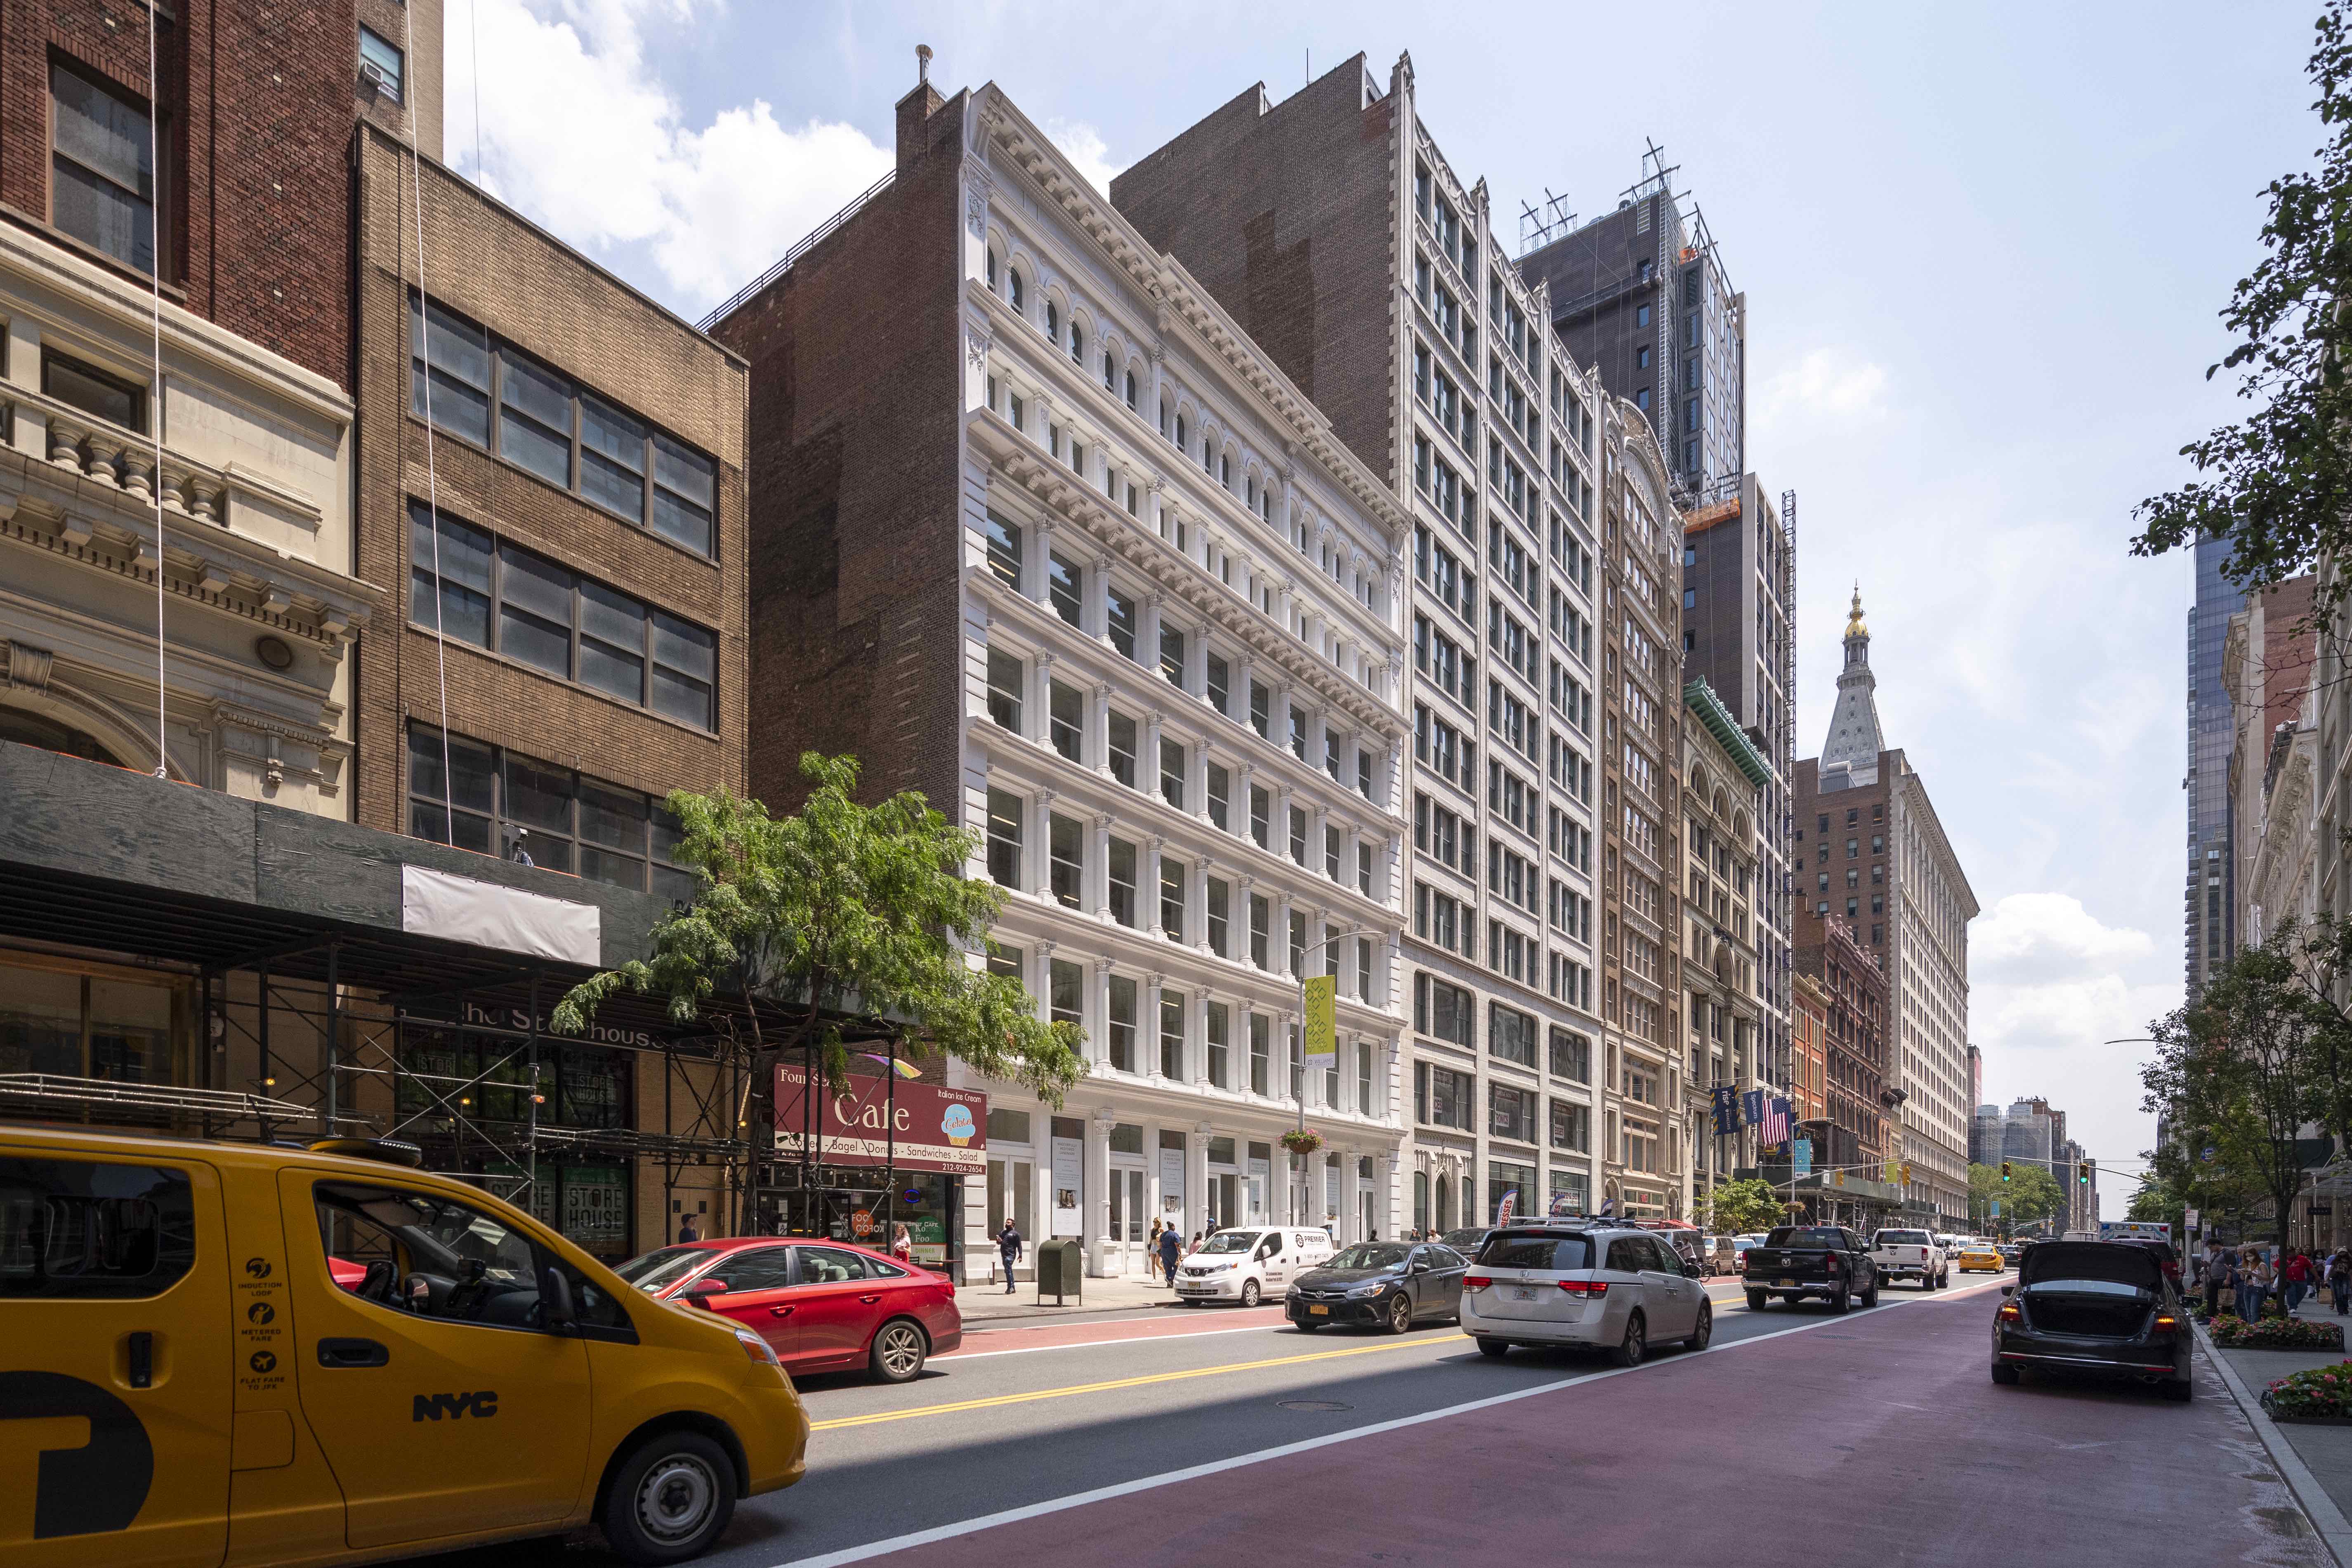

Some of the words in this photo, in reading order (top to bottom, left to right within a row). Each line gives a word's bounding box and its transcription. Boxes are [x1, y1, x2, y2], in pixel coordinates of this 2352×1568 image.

[938, 1089, 955, 1099] Italian
[965, 1093, 981, 1103] Cream
[1722, 1090, 1730, 1105] rise
[835, 1093, 910, 1131] Cafe
[832, 1139, 858, 1153] Bagel
[907, 1146, 951, 1159] Sandwiches
[959, 1151, 978, 1162] Salad
[942, 1163, 982, 1173] 212-924-2654
[569, 1188, 622, 1208] STORE
[569, 1209, 622, 1230] HOUSE
[413, 1391, 498, 1422] NYC
